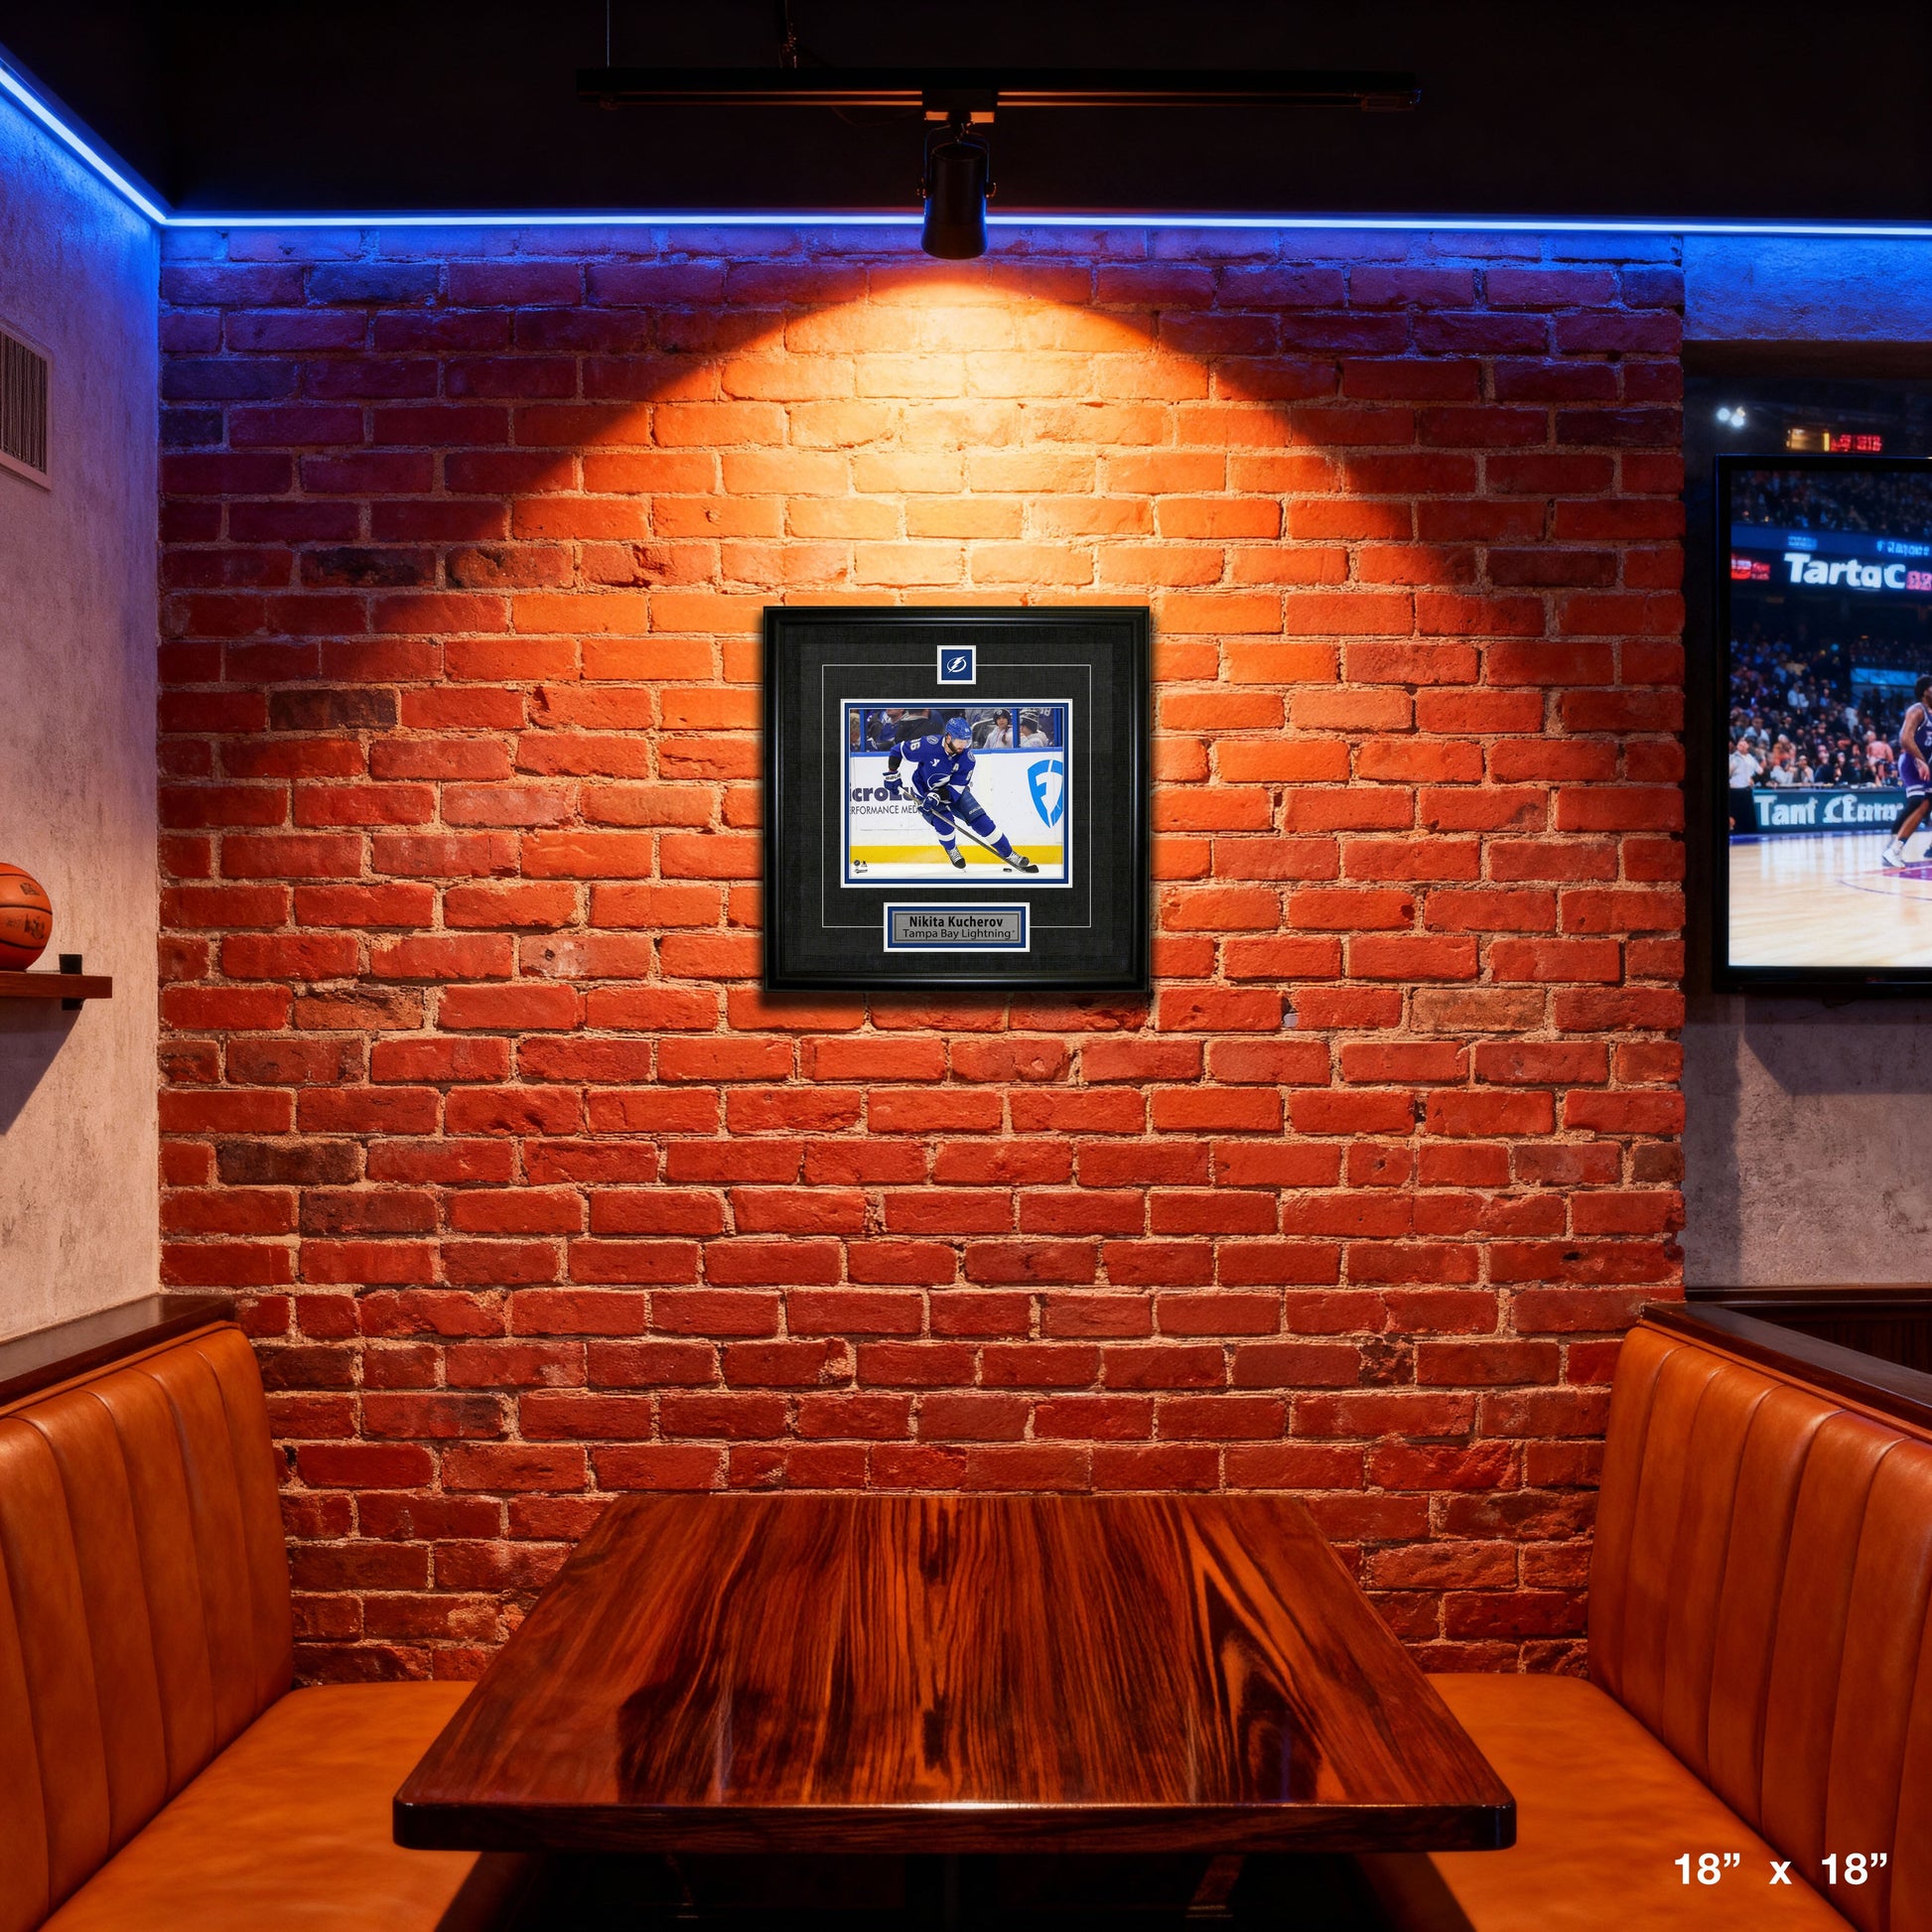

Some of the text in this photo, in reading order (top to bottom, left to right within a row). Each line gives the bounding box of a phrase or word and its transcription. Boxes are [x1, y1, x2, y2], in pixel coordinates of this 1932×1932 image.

[909, 915, 1004, 927] Nikita Kucherov
[902, 928, 938, 940] Tampa
[941, 928, 959, 940] Bay
